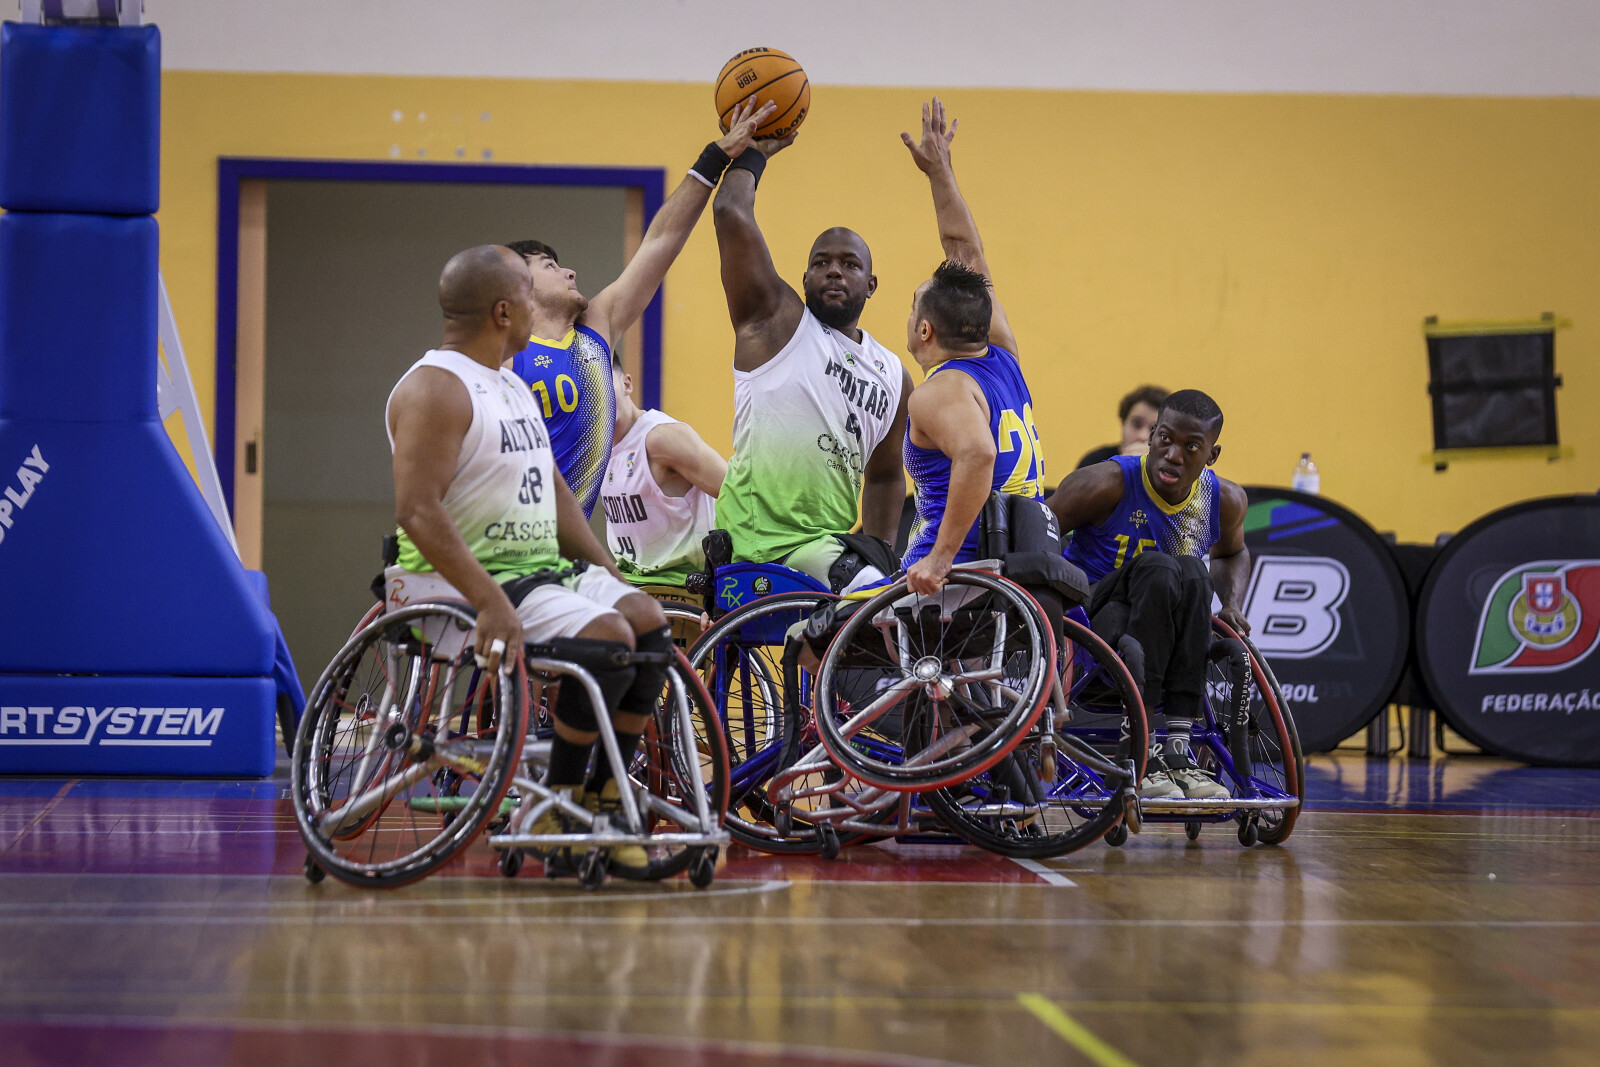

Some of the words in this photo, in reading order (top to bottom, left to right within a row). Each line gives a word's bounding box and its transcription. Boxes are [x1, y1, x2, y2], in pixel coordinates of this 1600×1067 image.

[737, 71, 758, 89] FIBA
[531, 374, 579, 418] 10
[0, 444, 51, 545] PLAY
